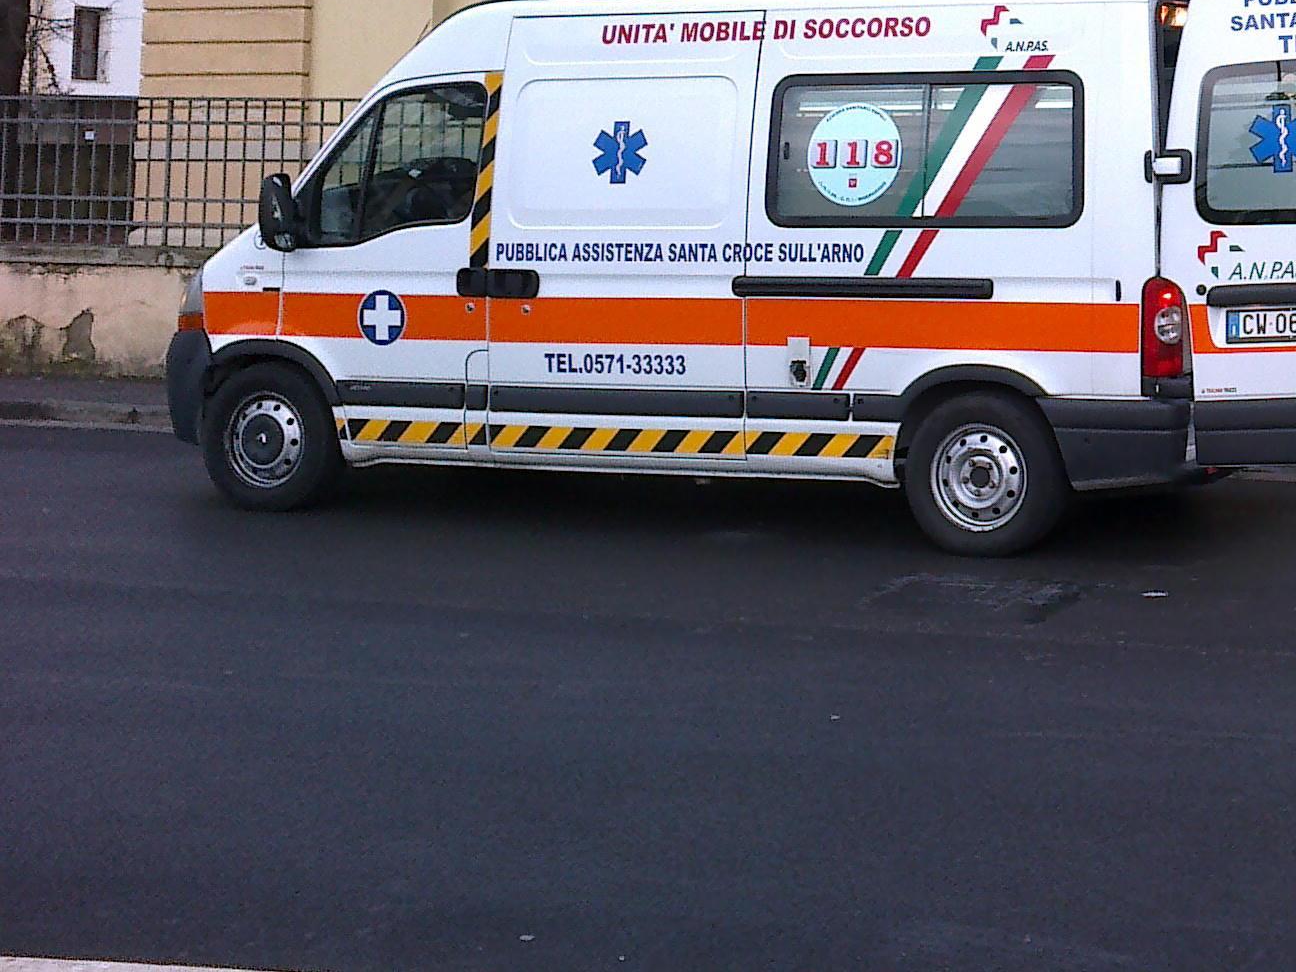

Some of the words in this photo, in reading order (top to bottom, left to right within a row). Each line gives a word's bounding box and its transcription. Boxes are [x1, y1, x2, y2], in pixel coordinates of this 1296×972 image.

[601, 23, 675, 45] UNITA'
[680, 21, 766, 43] MOBILE
[773, 19, 796, 40] DI
[803, 16, 931, 40] SOCCORSO
[815, 139, 894, 166] 118
[496, 242, 568, 262] PUBBLICA
[571, 242, 664, 262] ASSISTENZA
[667, 242, 718, 263] SANTA
[722, 243, 774, 263] CROCE
[778, 243, 865, 263] SULL'ARNO
[544, 353, 687, 375] TEL.0571-33333
